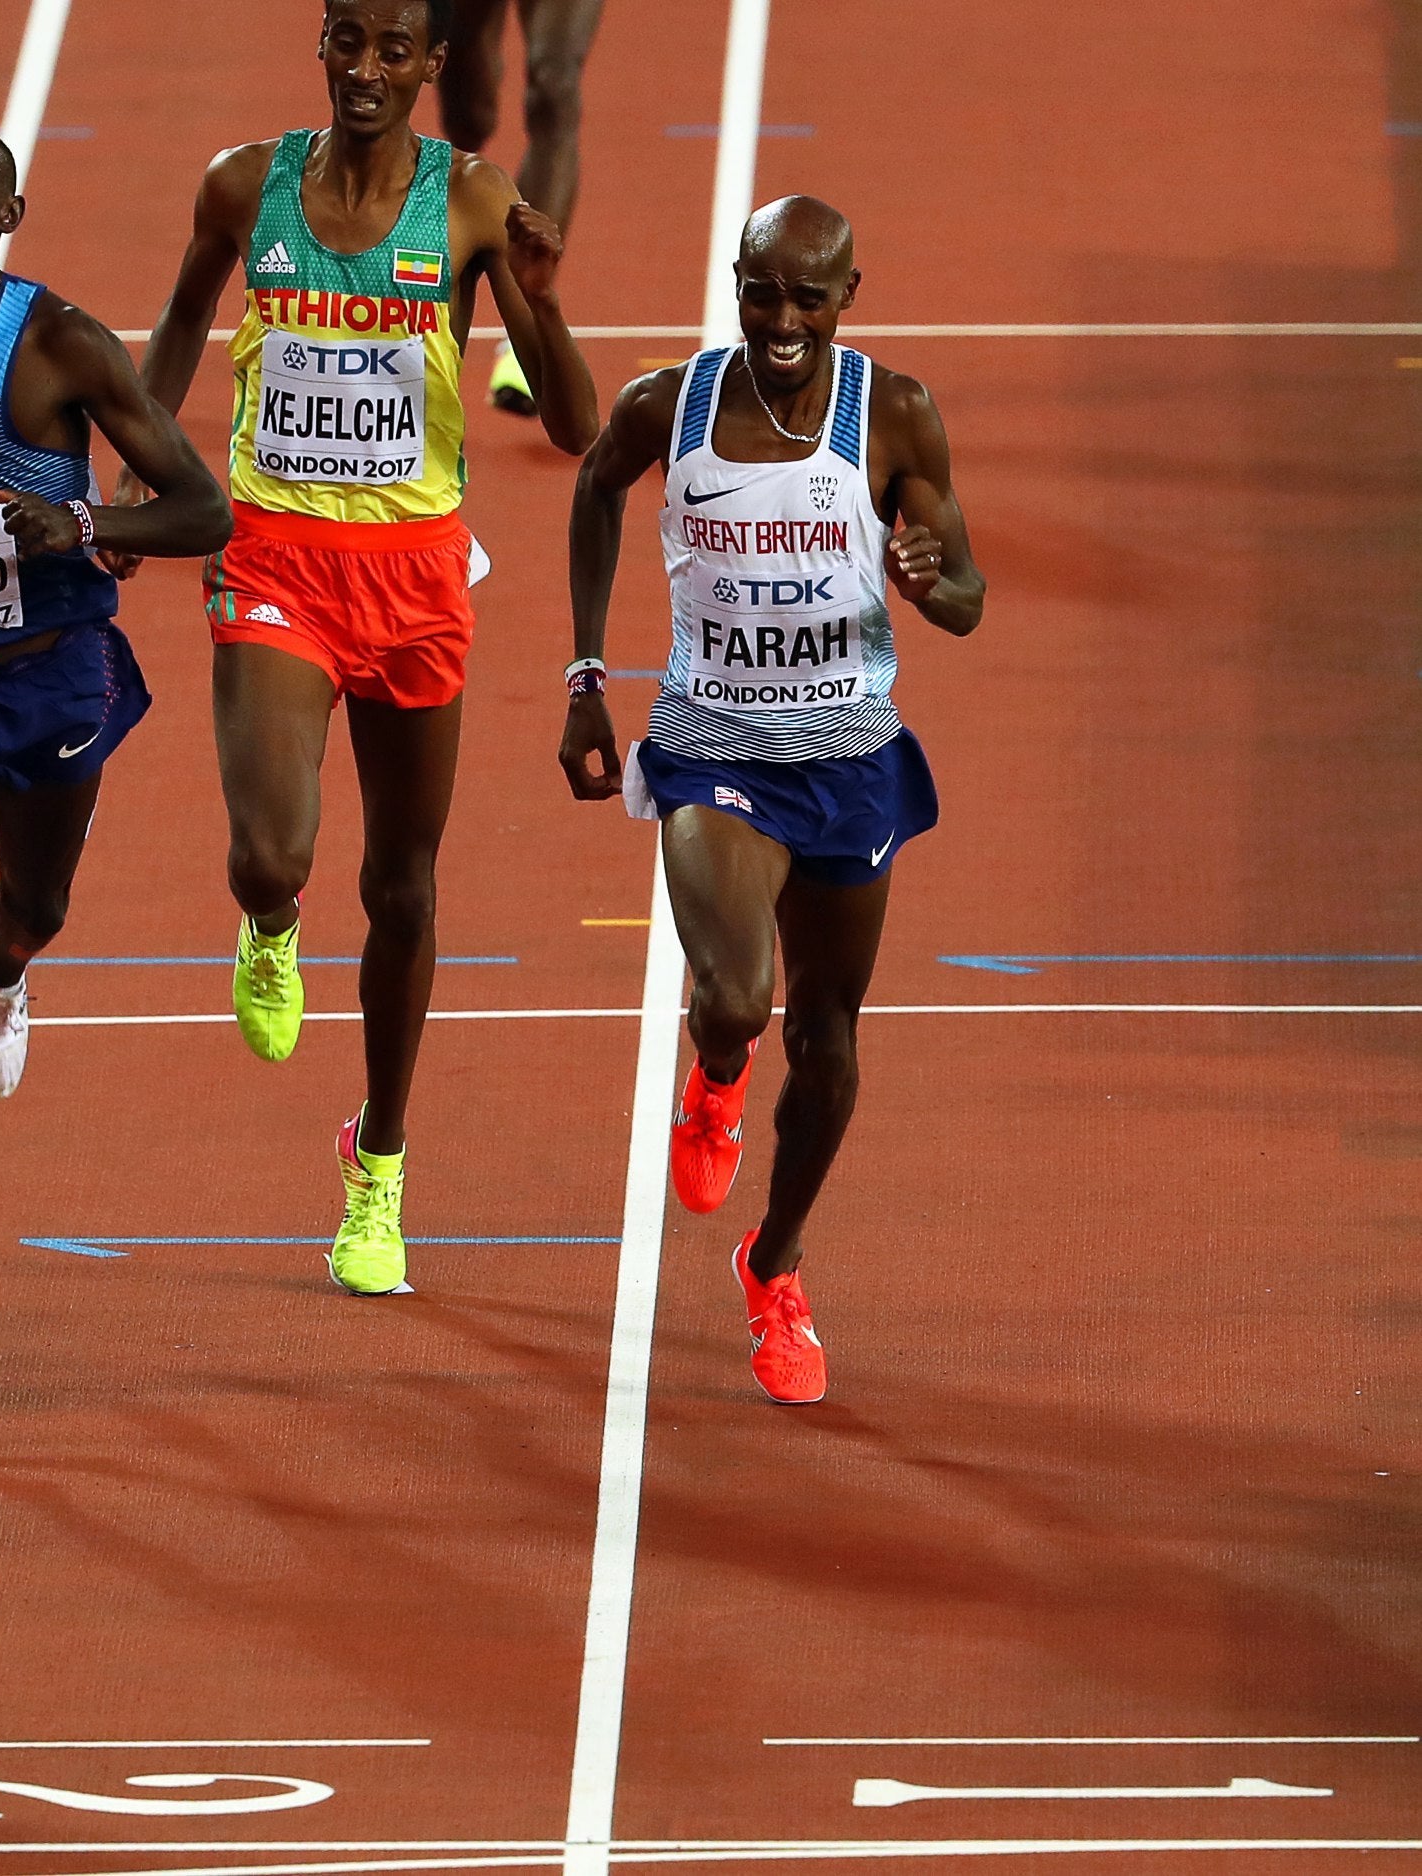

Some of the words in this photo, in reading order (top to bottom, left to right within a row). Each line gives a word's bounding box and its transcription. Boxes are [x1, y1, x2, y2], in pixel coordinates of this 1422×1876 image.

[256, 258, 296, 274] adidas
[254, 288, 439, 334] ETHIOPIA
[308, 347, 401, 375] TDK
[262, 387, 416, 442] KEJELCHA
[258, 449, 358, 477] LONDON
[362, 456, 417, 478] 2017
[682, 514, 752, 554] GREAT
[756, 521, 848, 555] BRITAIN
[739, 575, 834, 606] TDK
[702, 616, 848, 668] FARAH
[692, 677, 800, 705] LONDON
[803, 677, 857, 702] 2017
